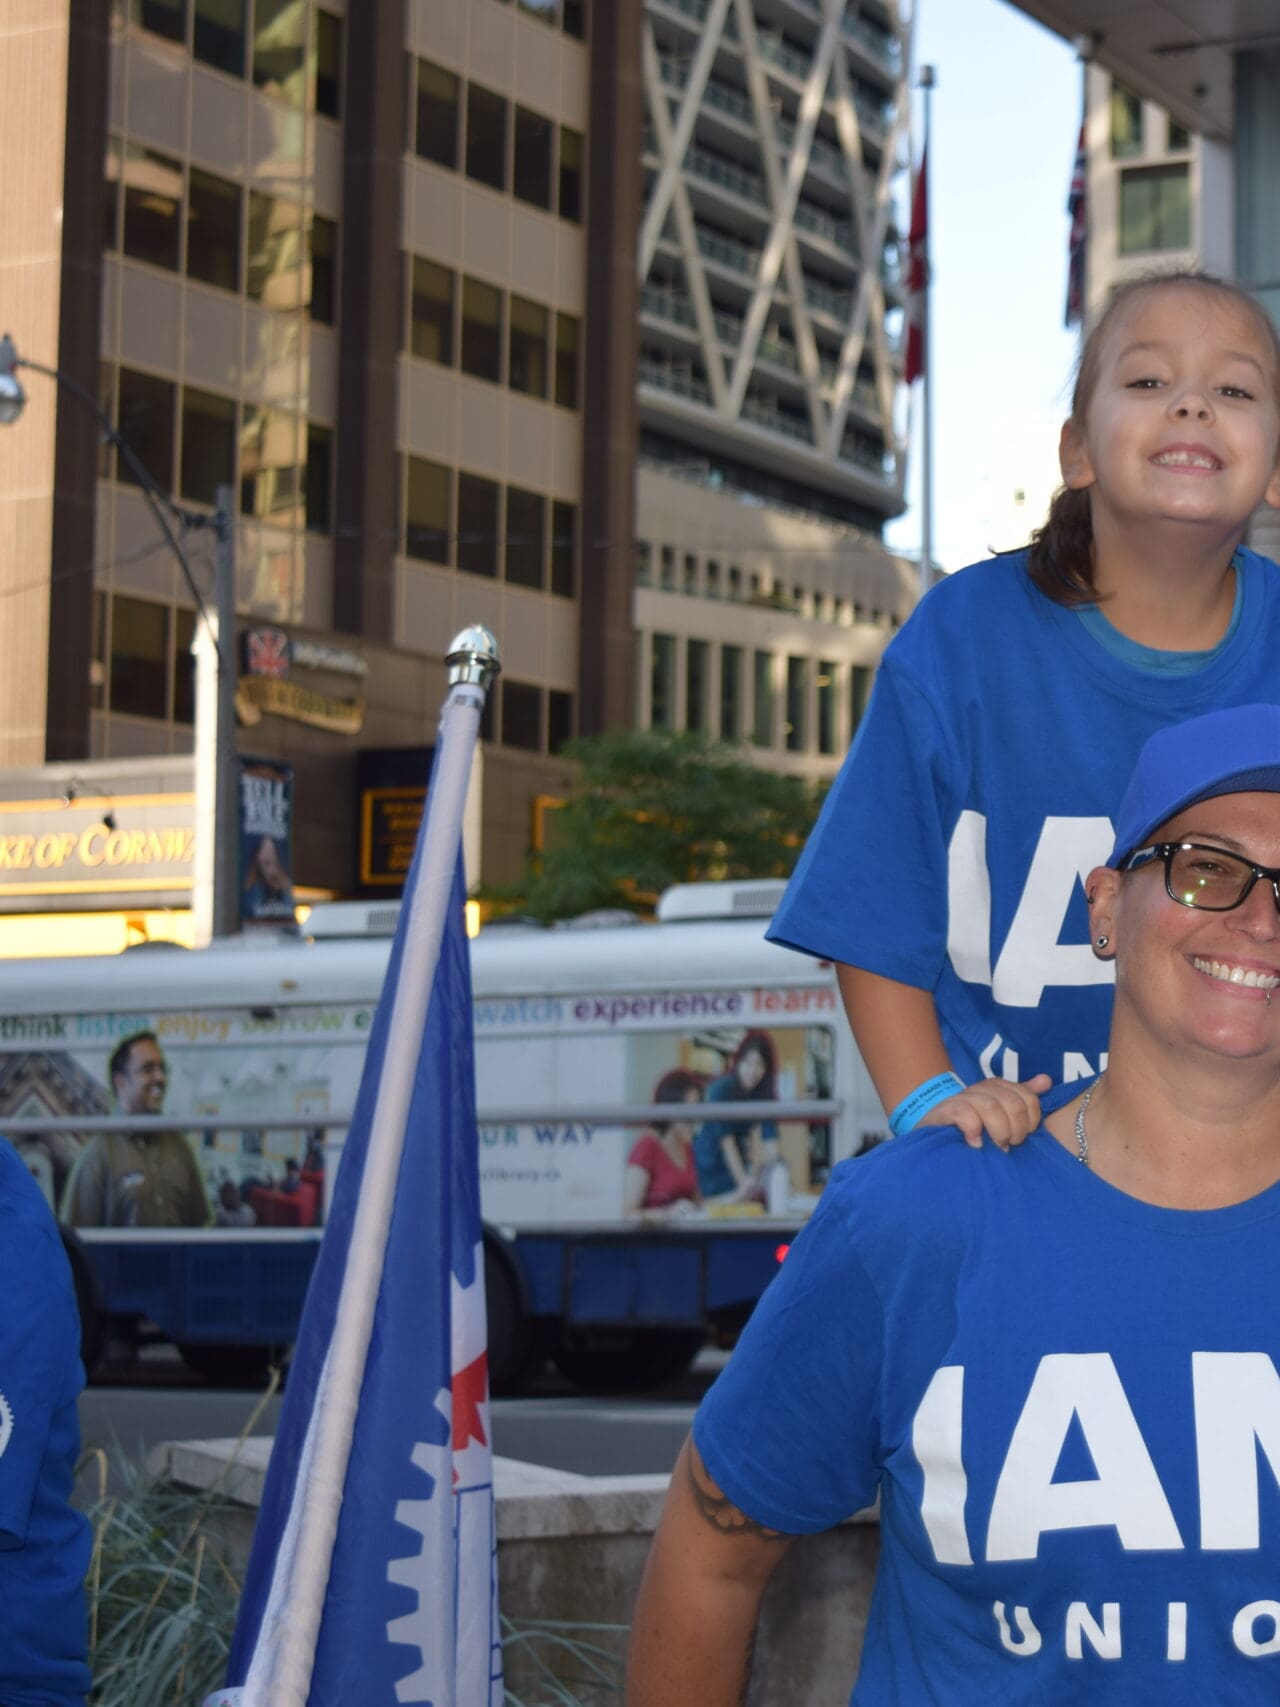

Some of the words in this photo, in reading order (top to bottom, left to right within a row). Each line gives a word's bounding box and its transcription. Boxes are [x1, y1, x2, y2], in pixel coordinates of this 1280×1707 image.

[34, 831, 78, 869] OF
[1, 1011, 68, 1041] think
[76, 1010, 150, 1038] listen
[157, 1010, 232, 1041] enjoy
[474, 994, 563, 1026] watch
[573, 990, 742, 1026] experience
[752, 985, 837, 1014] learn
[534, 1122, 597, 1146] WAY
